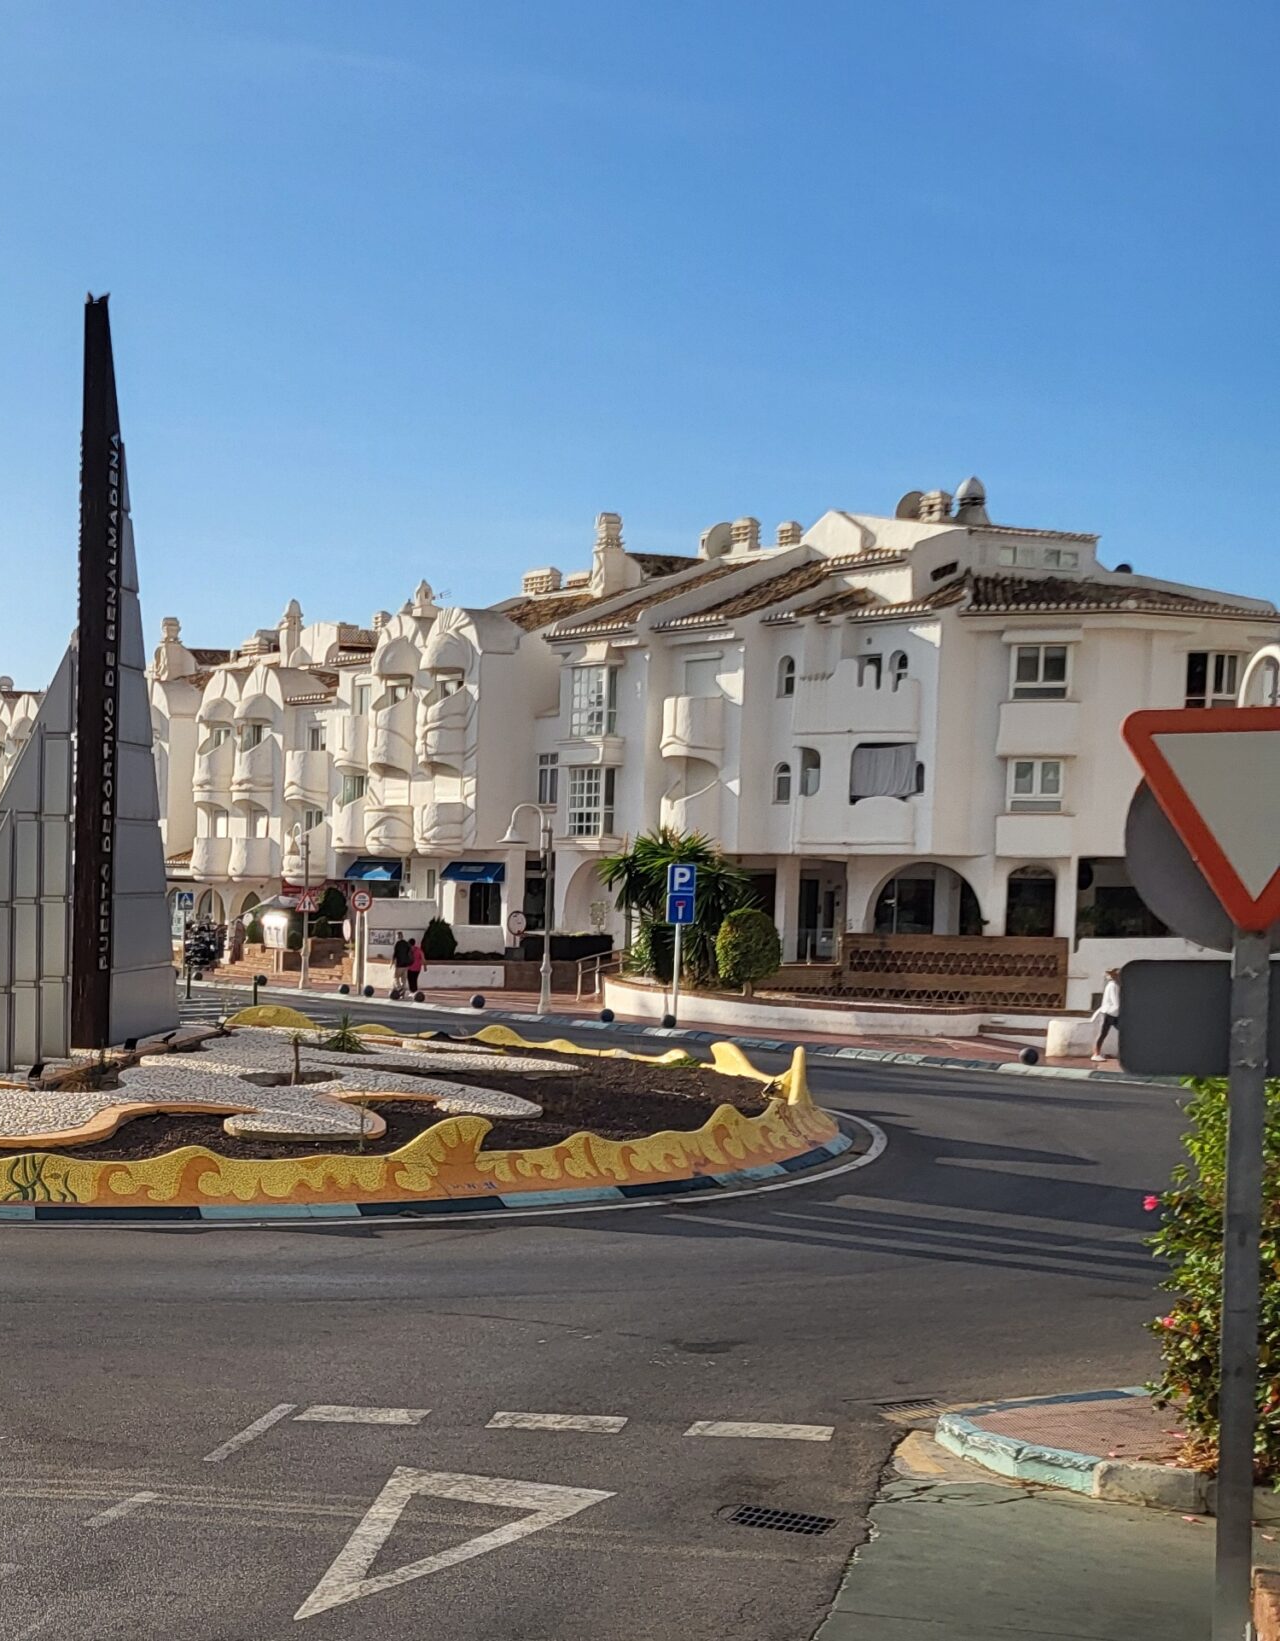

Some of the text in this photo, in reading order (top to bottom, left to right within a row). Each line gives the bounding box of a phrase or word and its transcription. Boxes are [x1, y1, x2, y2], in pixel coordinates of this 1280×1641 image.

[99, 432, 119, 970] PUERTO DEPORTIVO DE BENALMADENA
[674, 867, 690, 891] P
